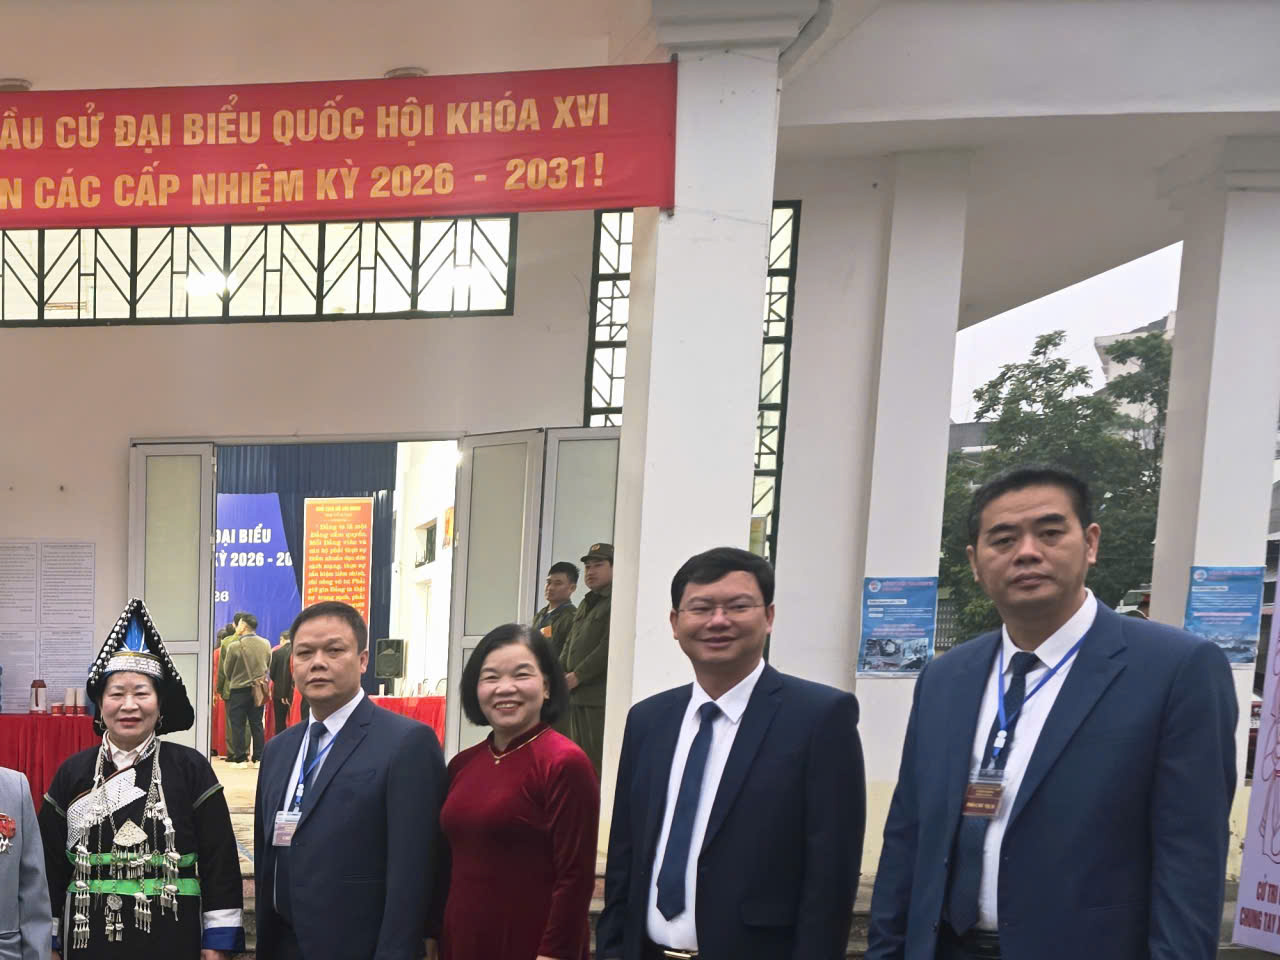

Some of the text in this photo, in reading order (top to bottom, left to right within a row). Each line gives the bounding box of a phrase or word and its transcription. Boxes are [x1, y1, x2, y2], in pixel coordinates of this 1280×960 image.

[56, 101, 104, 149] CỬ
[114, 113, 172, 154] ĐẠI
[184, 94, 262, 145] BIỂU
[273, 94, 366, 146] QUỐC
[377, 97, 435, 146] HỘI
[447, 91, 540, 136] KHÓA
[552, 93, 610, 130] XVI
[34, 167, 101, 209] CÁC
[114, 160, 181, 207] CẤP
[191, 163, 305, 212] NHIỆM
[316, 158, 362, 202] KỲ
[370, 162, 456, 198] 2026
[474, 175, 487, 183] -
[504, 153, 605, 191] 2031!
[239, 522, 272, 544] BIỂU
[230, 552, 265, 567] 2026
[276, 552, 293, 567] 20
